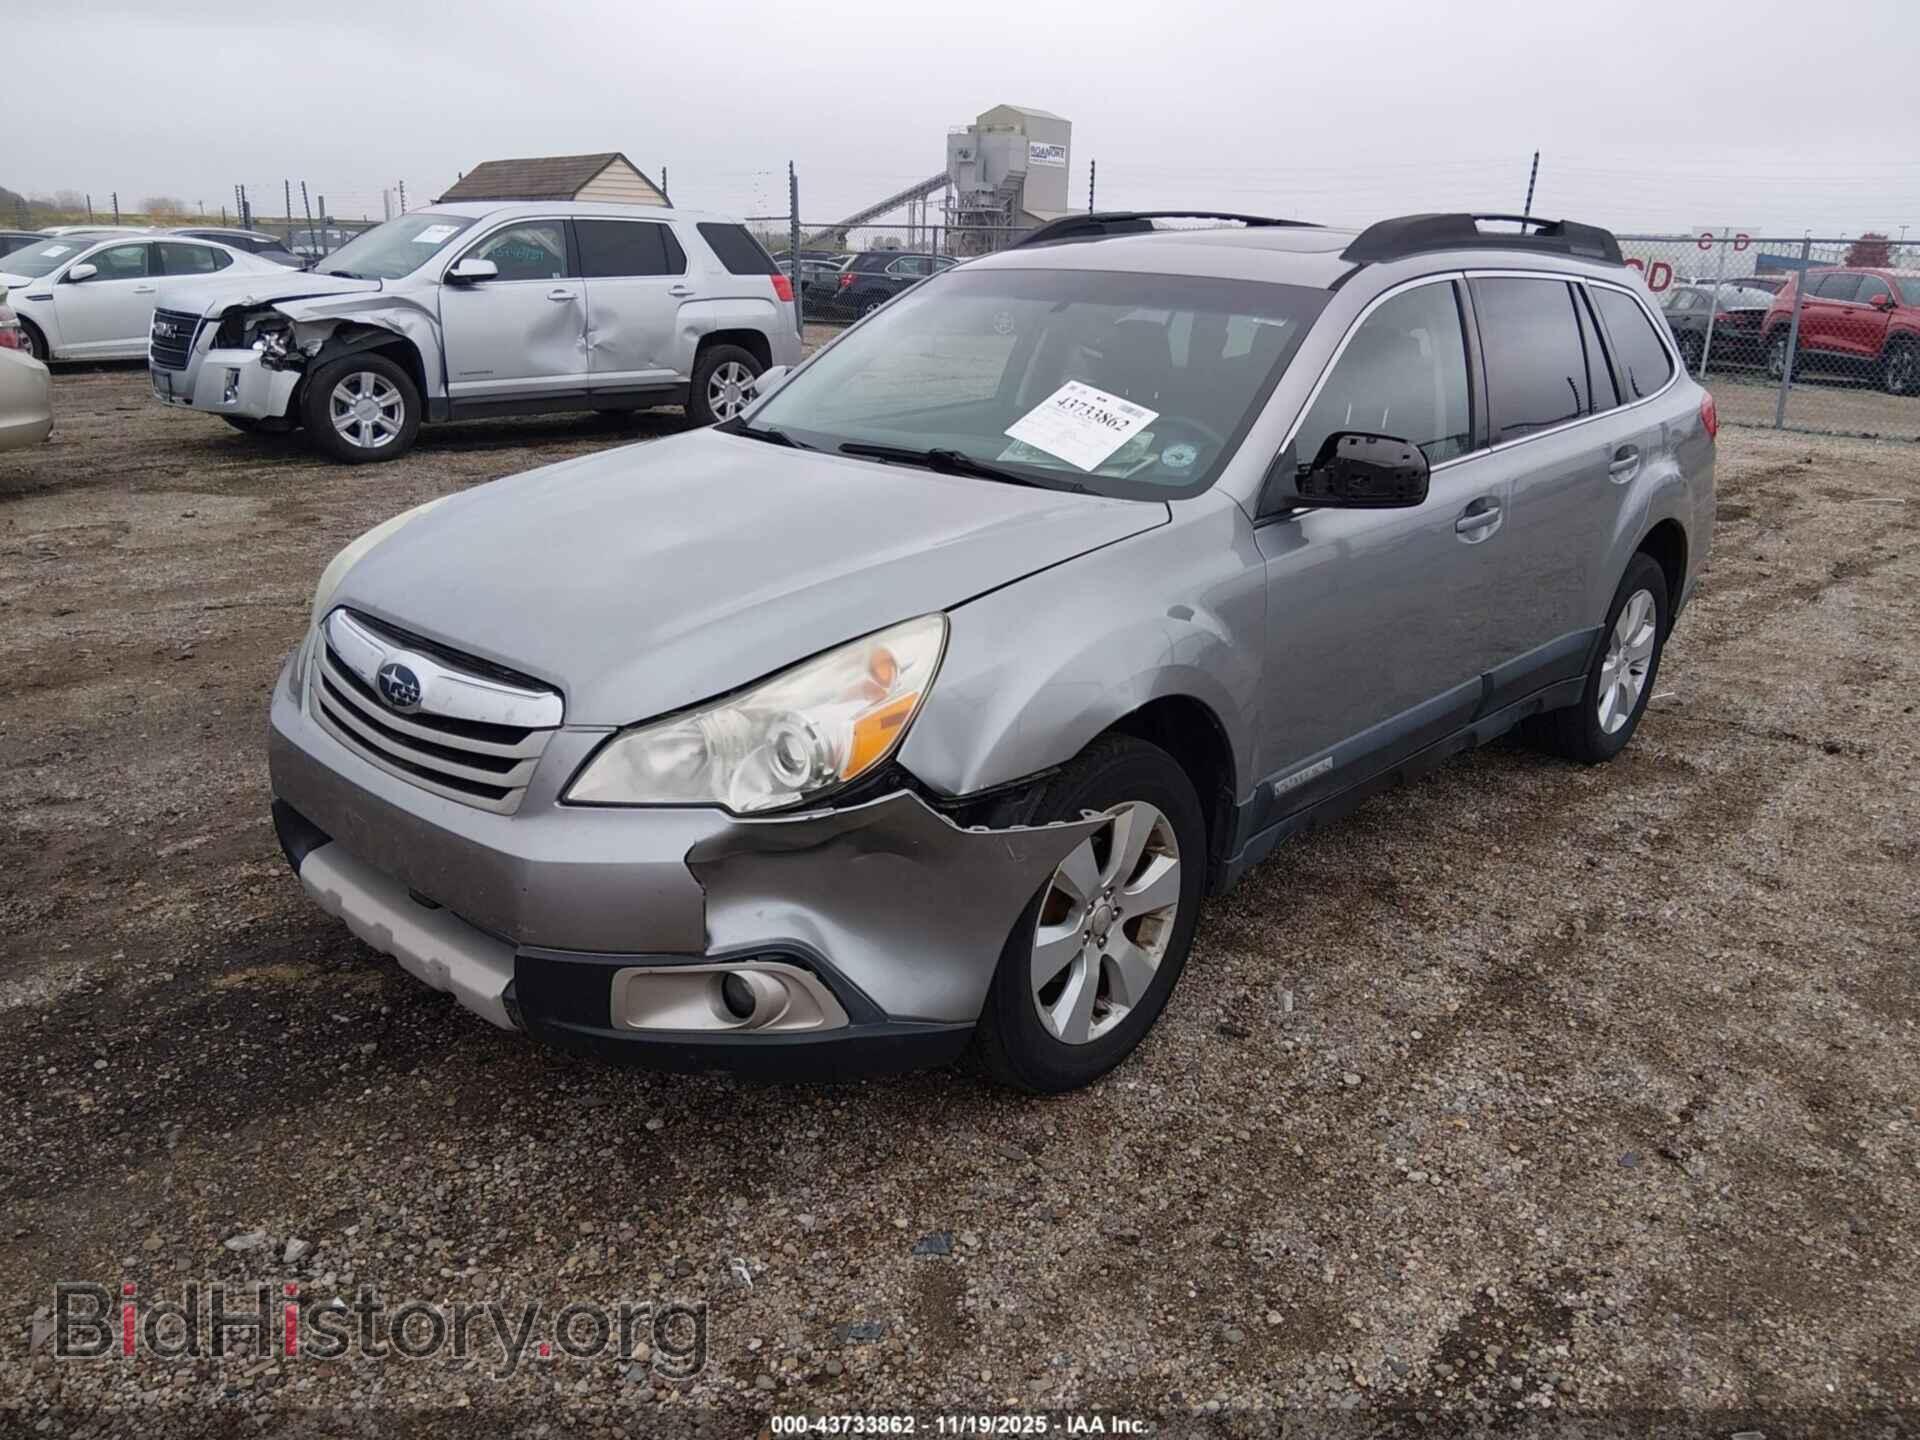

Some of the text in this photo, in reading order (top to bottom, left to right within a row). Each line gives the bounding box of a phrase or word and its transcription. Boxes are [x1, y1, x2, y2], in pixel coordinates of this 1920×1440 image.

[1698, 232, 1749, 251] C D
[1056, 396, 1130, 432] 43733862
